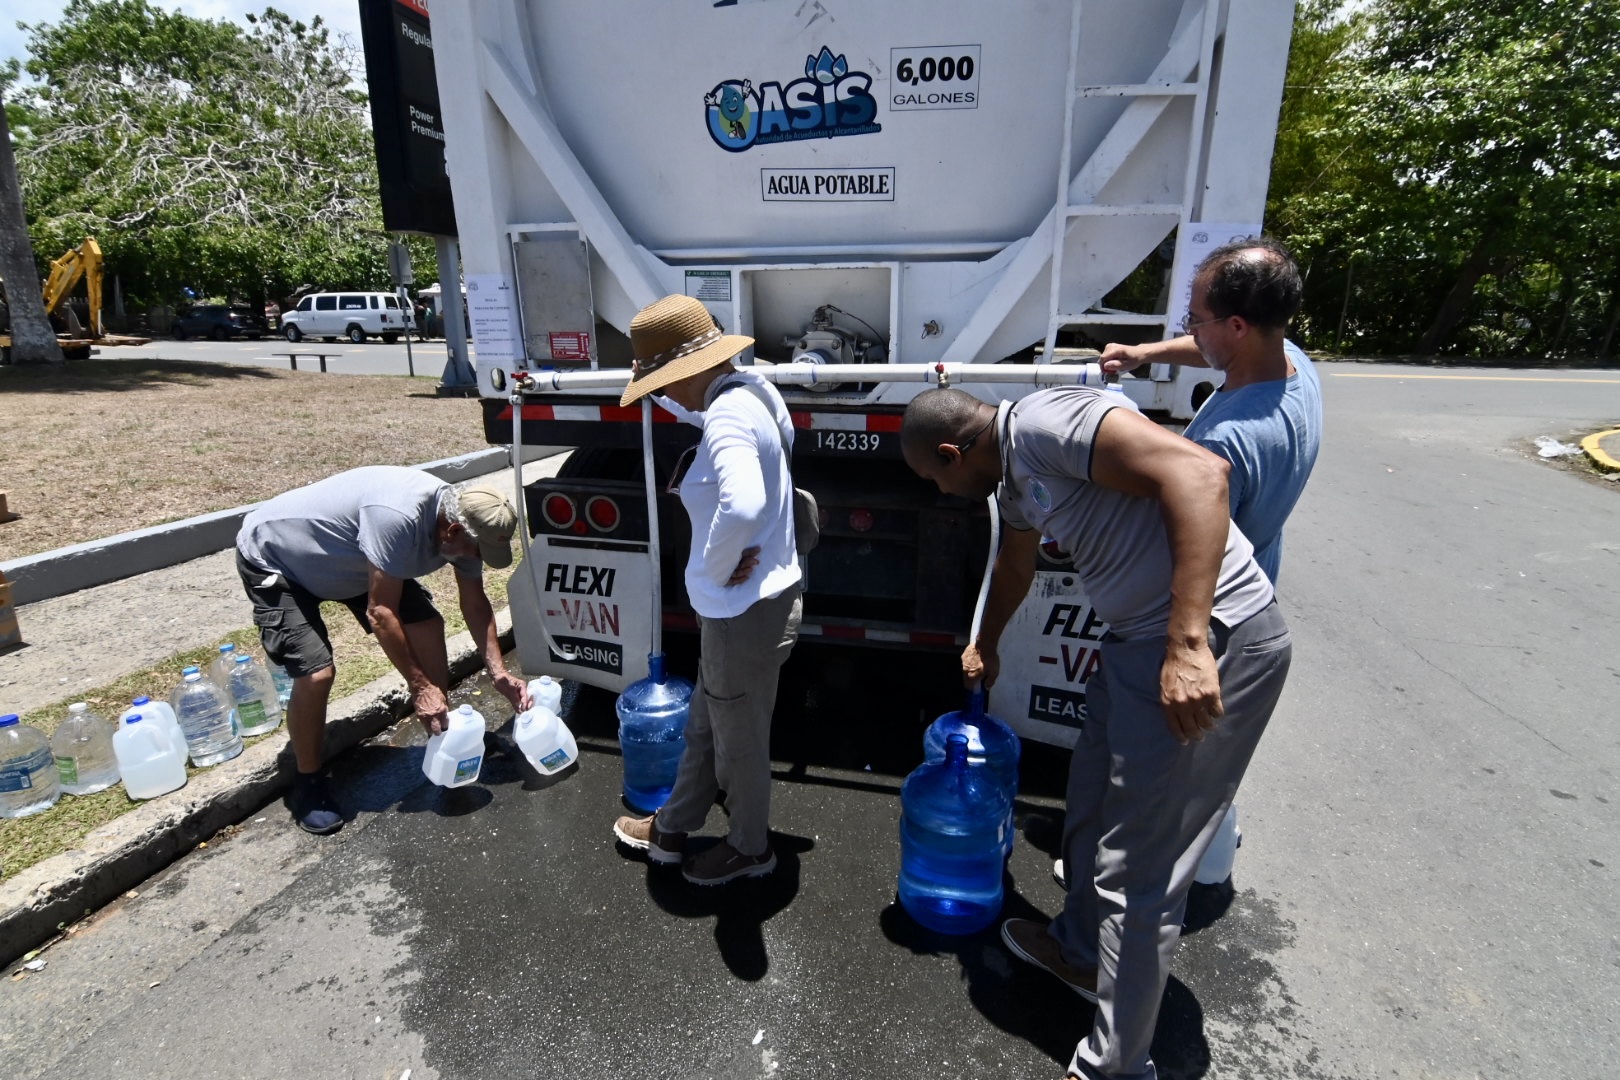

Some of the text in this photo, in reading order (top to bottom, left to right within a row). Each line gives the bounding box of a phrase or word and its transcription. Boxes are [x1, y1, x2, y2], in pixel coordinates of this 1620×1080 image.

[401, 22, 432, 48] Regula
[896, 56, 974, 85] 6,000
[893, 91, 975, 106] GALONES
[409, 105, 434, 124] Power
[411, 121, 445, 141] Premium
[784, 131, 793, 141] de
[767, 174, 889, 194] AGUA POTABLE
[816, 432, 880, 451] 142339
[544, 563, 616, 597] FLEXI
[1042, 603, 1111, 641] FLE
[555, 642, 619, 667] EASING
[1038, 644, 1101, 685] -VA
[1034, 695, 1088, 721] LEAS
